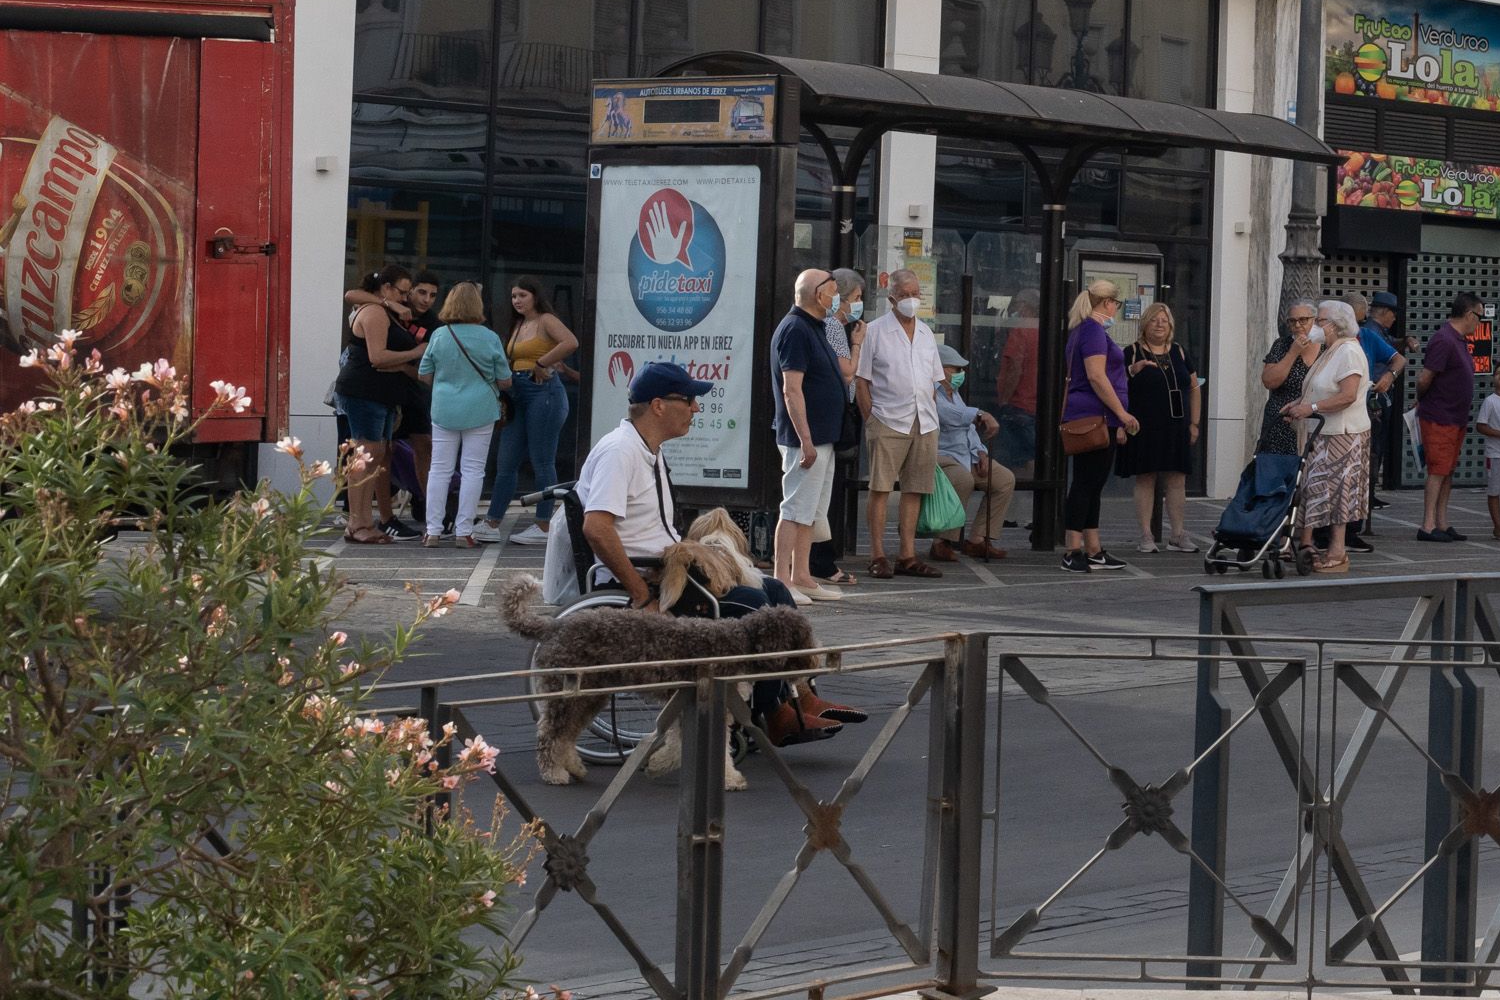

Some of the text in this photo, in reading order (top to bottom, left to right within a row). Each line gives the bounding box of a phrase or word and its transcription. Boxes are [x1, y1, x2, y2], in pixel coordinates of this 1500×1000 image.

[1354, 13, 1412, 41] Frutas
[1420, 24, 1489, 51] Verduras
[1387, 41, 1479, 88] Lola
[639, 87, 727, 96] AUTOBUSES URBANOS DE JEREZ
[696, 178, 756, 186] WWW.PIDETAXI.ES
[1394, 161, 1495, 184] Frutas Verduras
[1420, 178, 1494, 208] Lola
[19, 126, 102, 350] ruzcampo
[90, 208, 123, 250] 1904
[90, 251, 113, 292] CERVEZA
[638, 270, 714, 300] pidetaxi
[656, 306, 667, 314] 956
[656, 318, 667, 326] 956
[676, 318, 684, 326] 93
[684, 318, 692, 326] 96
[608, 334, 733, 350] DESCUBRE TU NUEVA APP EN JEREZ
[711, 387, 725, 398] 60
[710, 402, 724, 414] 96
[710, 418, 722, 429] 45
